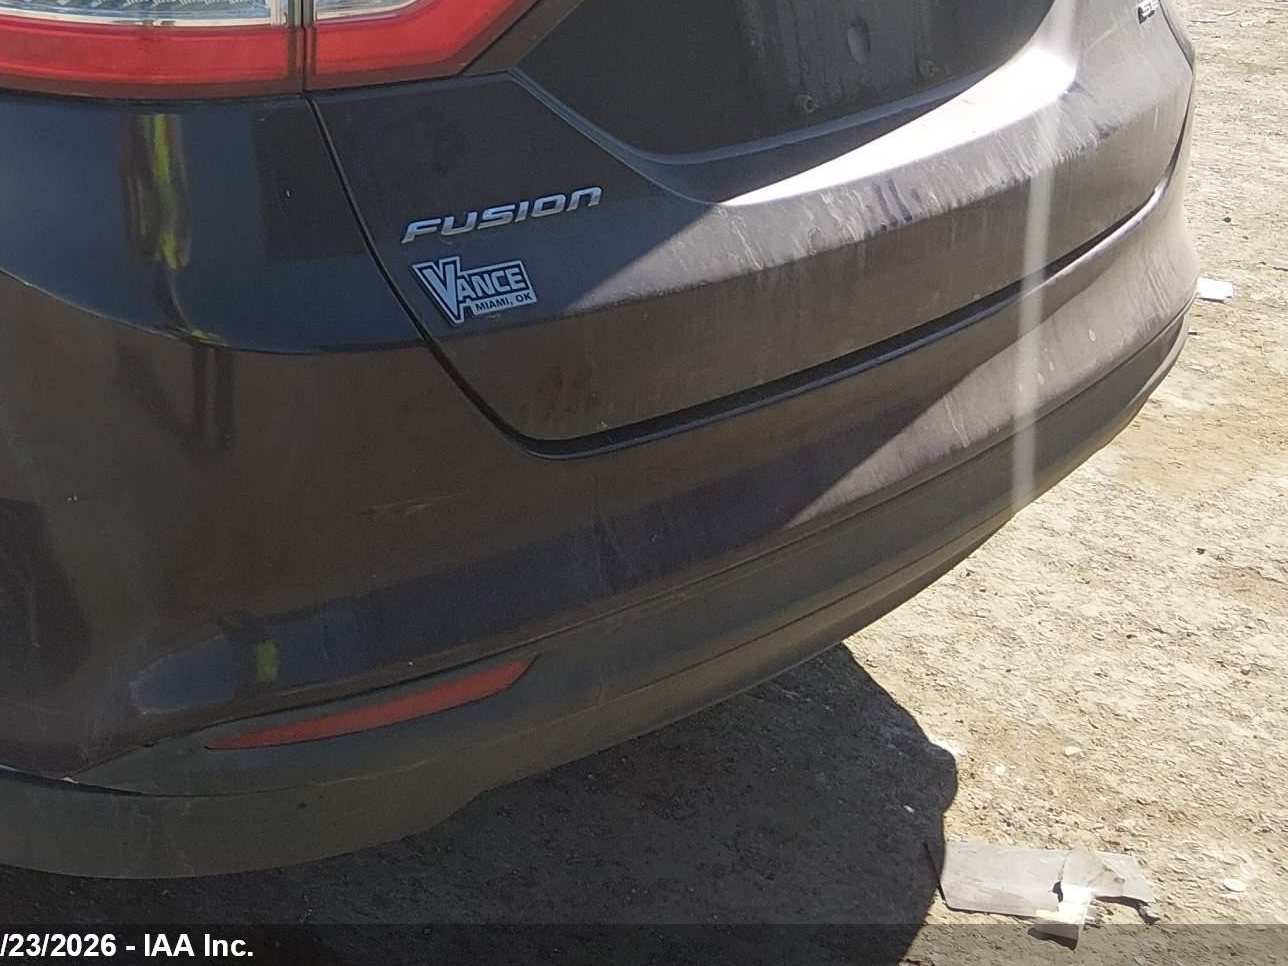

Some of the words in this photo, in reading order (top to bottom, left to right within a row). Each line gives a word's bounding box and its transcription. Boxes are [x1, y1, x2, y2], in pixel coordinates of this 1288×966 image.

[401, 185, 604, 244] FUSION
[415, 258, 527, 322] VANCE
[475, 296, 513, 313] MIAMI,
[516, 291, 534, 304] OK
